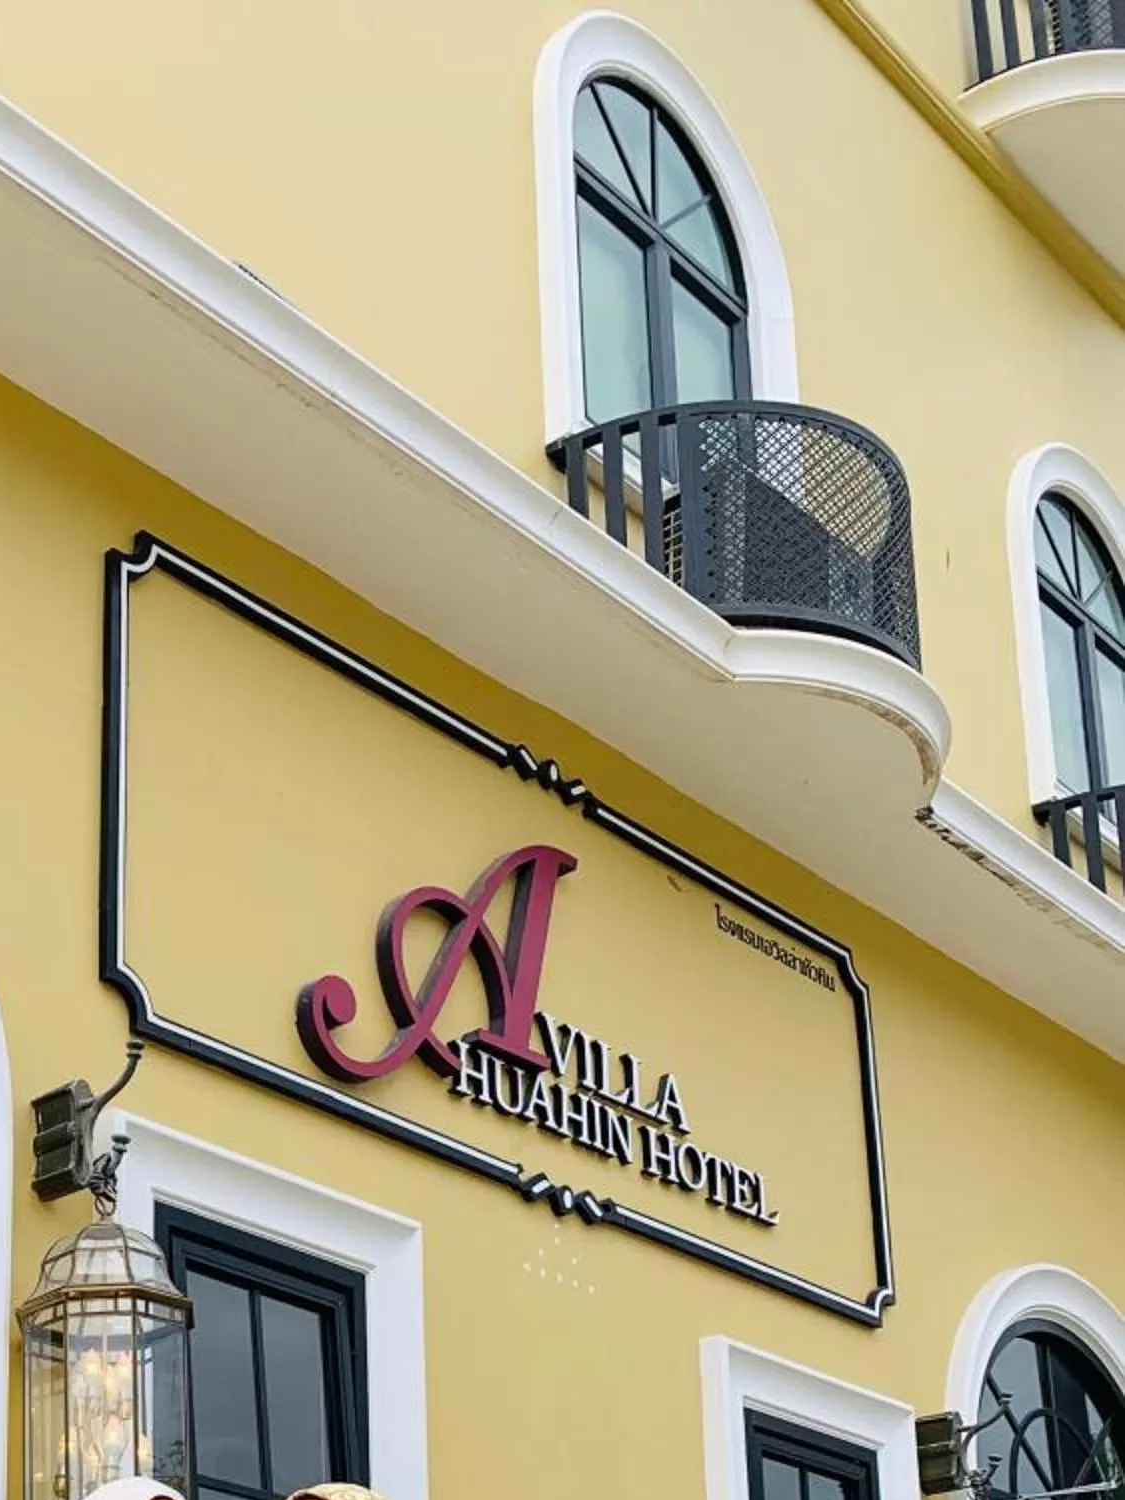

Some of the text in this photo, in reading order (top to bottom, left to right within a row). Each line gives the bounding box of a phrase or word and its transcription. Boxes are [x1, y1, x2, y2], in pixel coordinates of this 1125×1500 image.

[296, 845, 691, 1134] A VILLA
[448, 1039, 779, 1226] HUAHIN HOTEL
